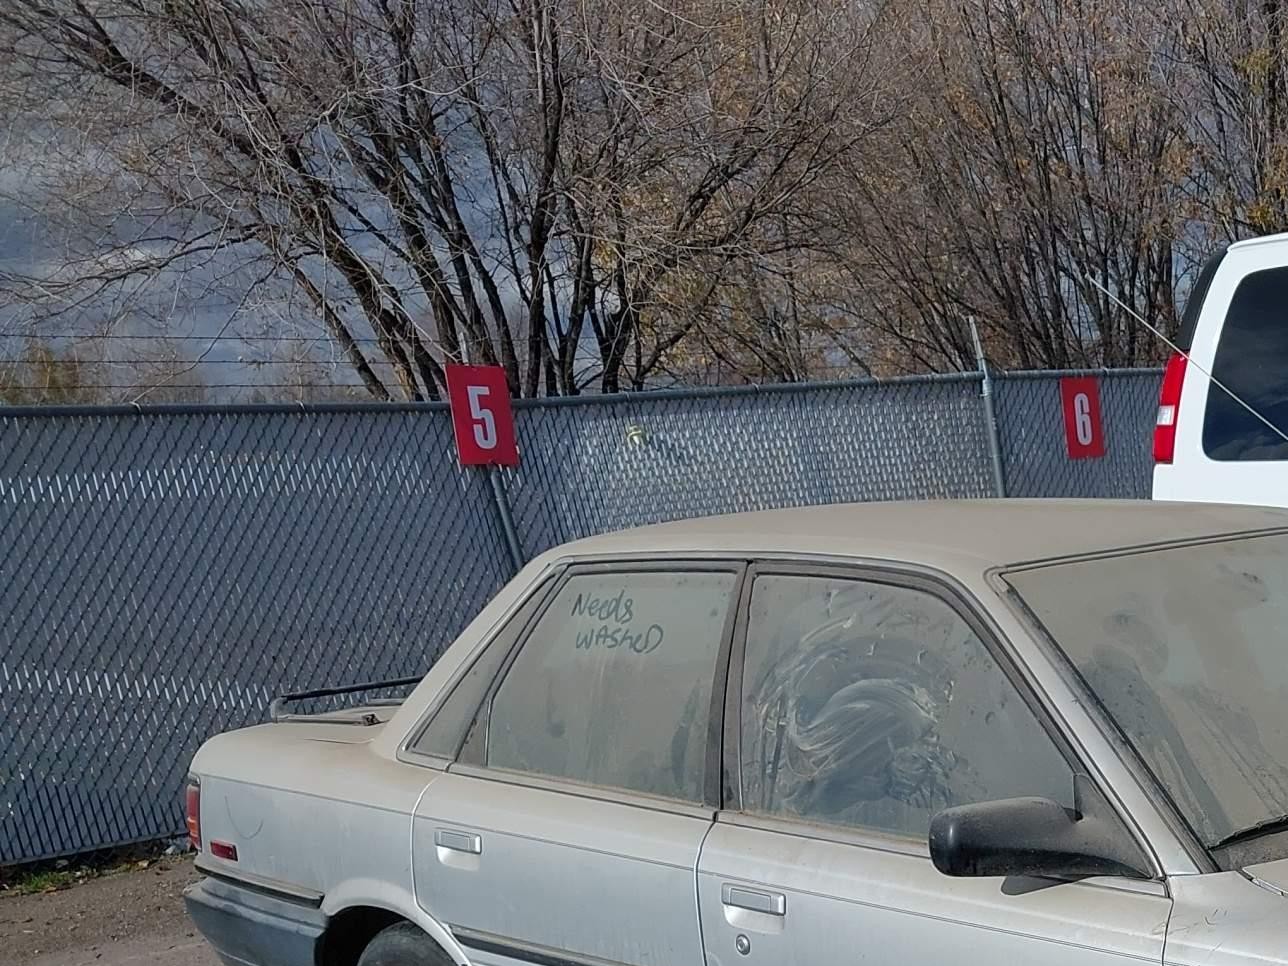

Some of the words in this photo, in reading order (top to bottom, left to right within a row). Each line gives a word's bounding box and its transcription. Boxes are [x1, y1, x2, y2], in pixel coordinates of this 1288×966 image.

[467, 385, 498, 450] 5
[1074, 393, 1093, 446] 6
[571, 589, 633, 624] Needs
